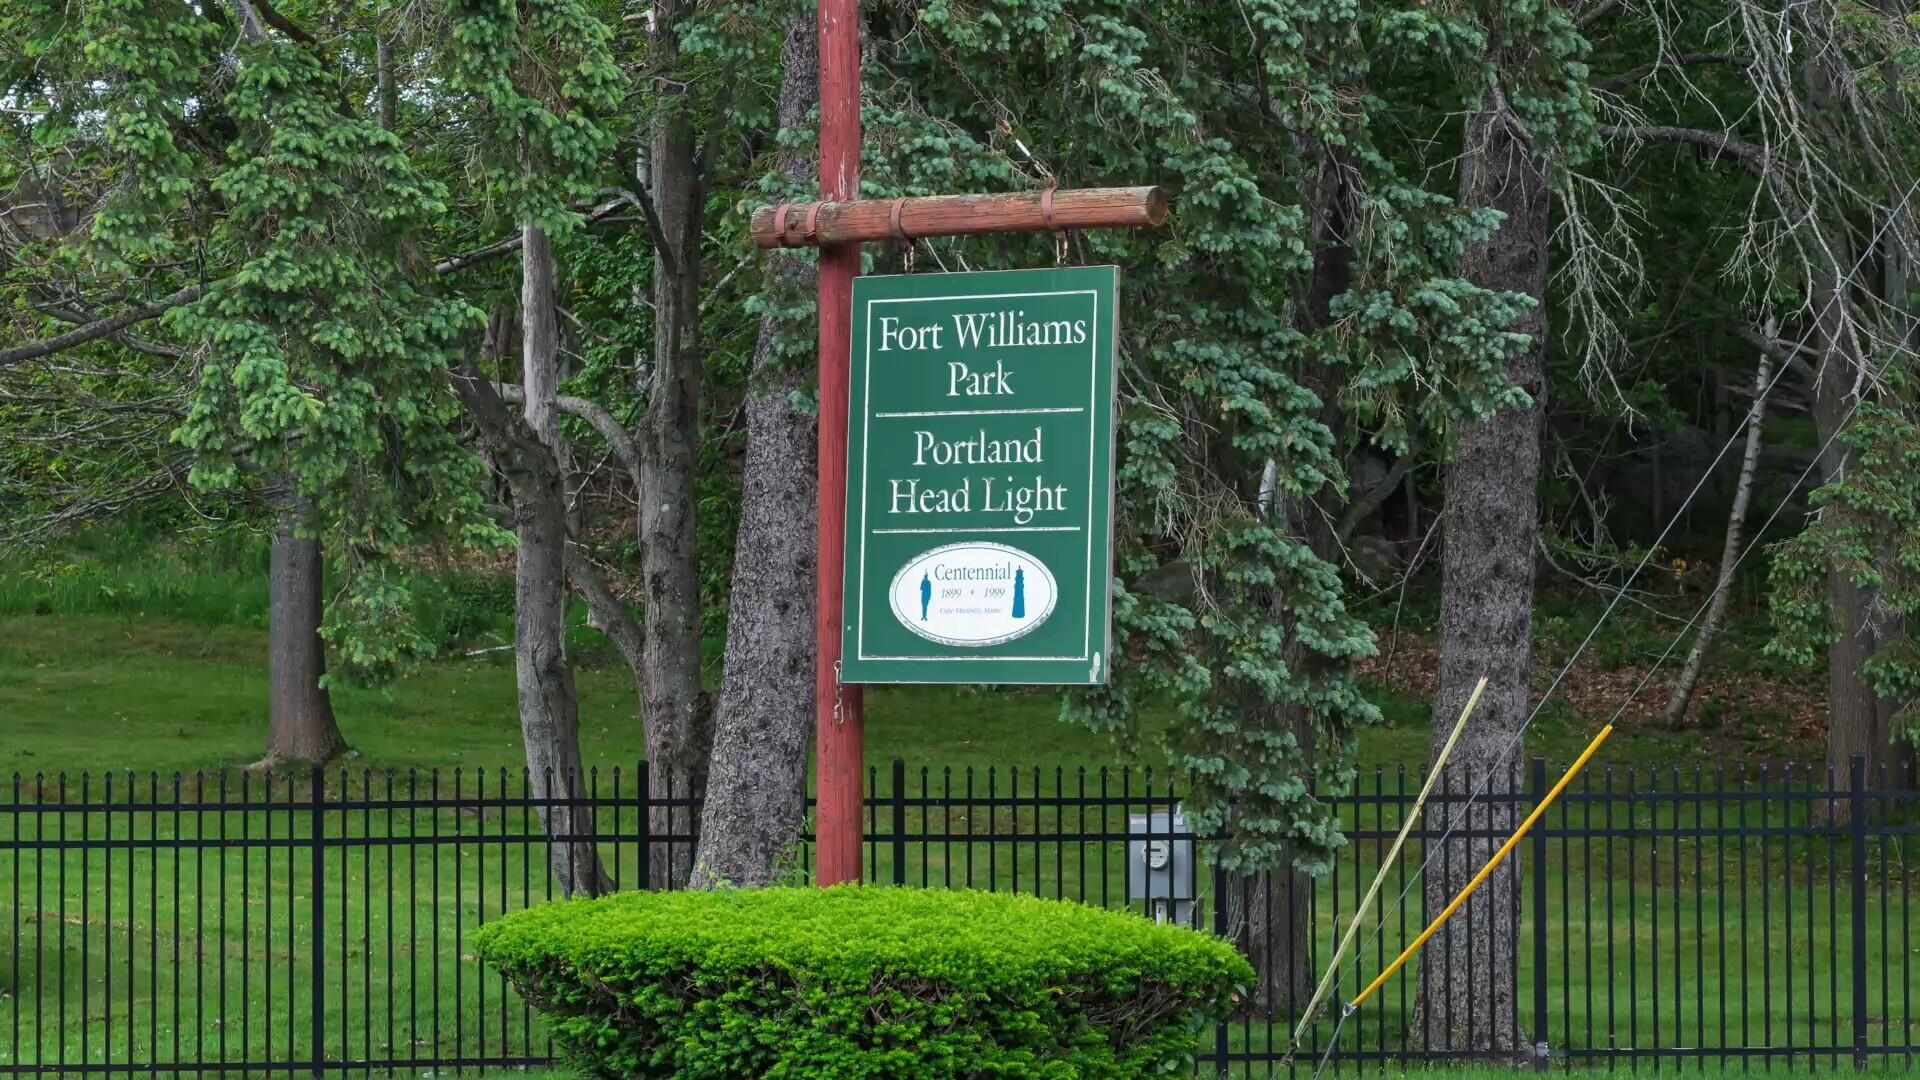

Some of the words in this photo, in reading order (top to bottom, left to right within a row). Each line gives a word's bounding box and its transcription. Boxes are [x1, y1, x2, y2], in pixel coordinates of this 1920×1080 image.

[878, 317, 943, 351] Fort
[952, 310, 1087, 349] Williams
[946, 359, 1014, 396] Park
[913, 427, 1044, 465] Portland
[888, 476, 971, 513] Head
[980, 475, 1068, 525] Light
[934, 561, 1011, 581] Centennial
[941, 588, 962, 599] 1899
[984, 587, 1005, 598] 1999
